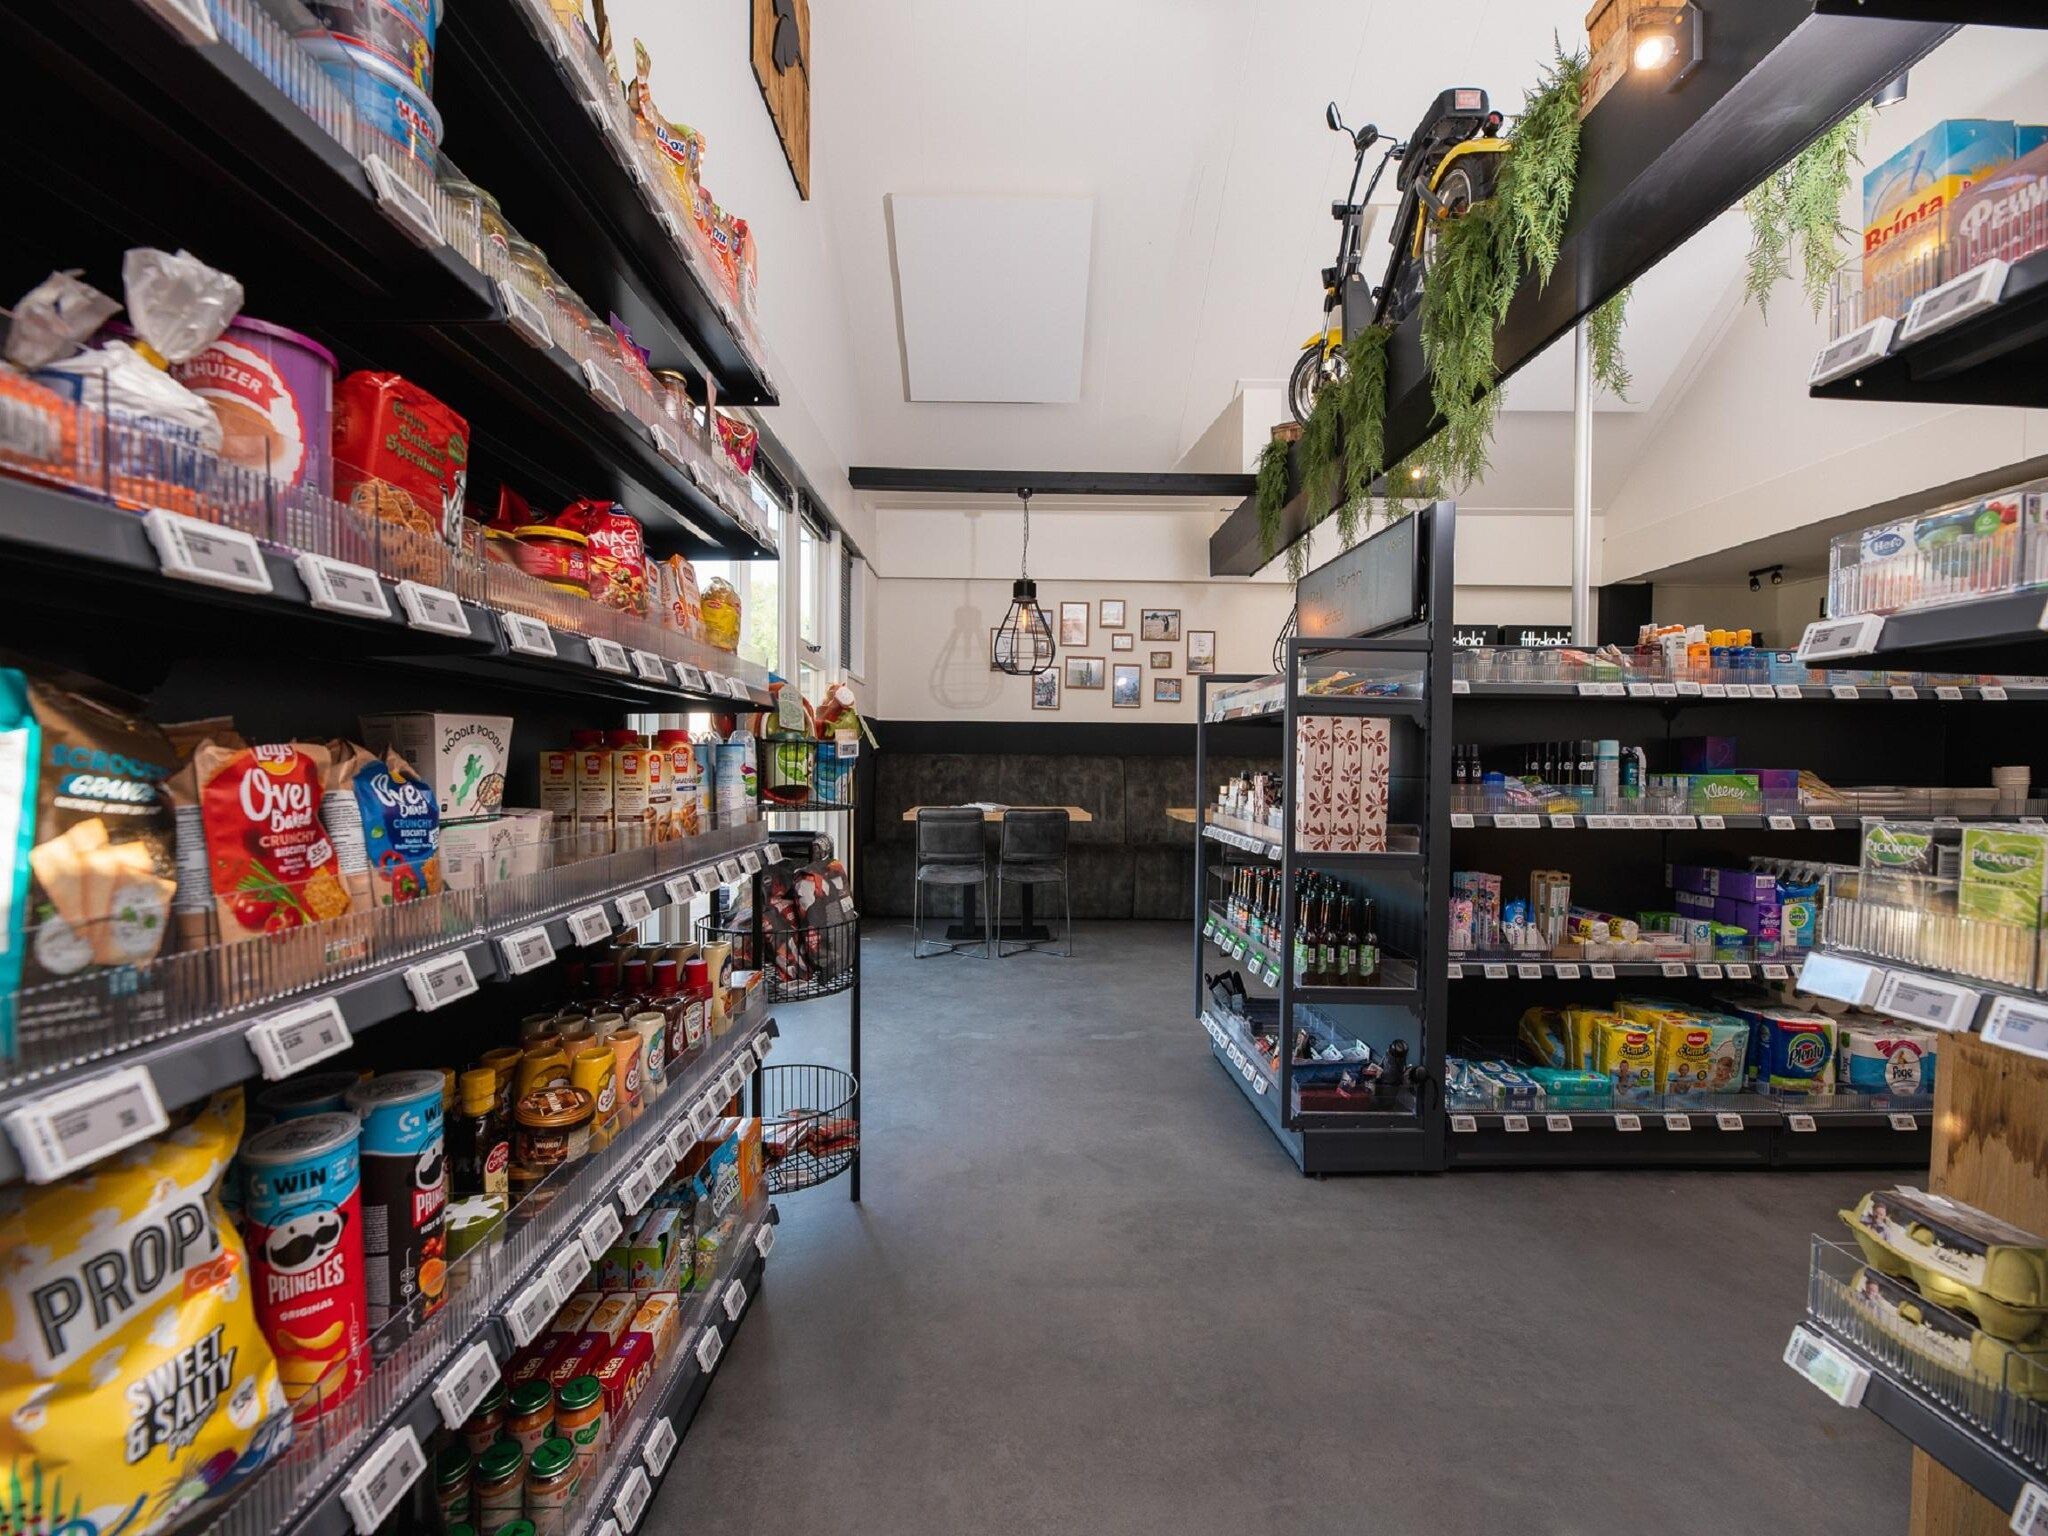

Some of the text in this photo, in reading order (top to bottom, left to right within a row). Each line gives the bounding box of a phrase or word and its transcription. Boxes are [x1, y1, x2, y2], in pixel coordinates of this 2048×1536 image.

[1863, 194, 1944, 252] Brinta
[442, 724, 504, 755] NOODLE POODLE
[1703, 783, 1747, 800] Kleenex
[393, 818, 432, 829] CRUNCHY
[259, 830, 316, 848] CRUNCHY
[1788, 1042, 1825, 1068] Plenty
[267, 1251, 346, 1306] PRINGLES
[279, 1297, 335, 1322] ORIGINAL
[126, 1323, 226, 1420] SWEET
[153, 1345, 238, 1444] SALTY
